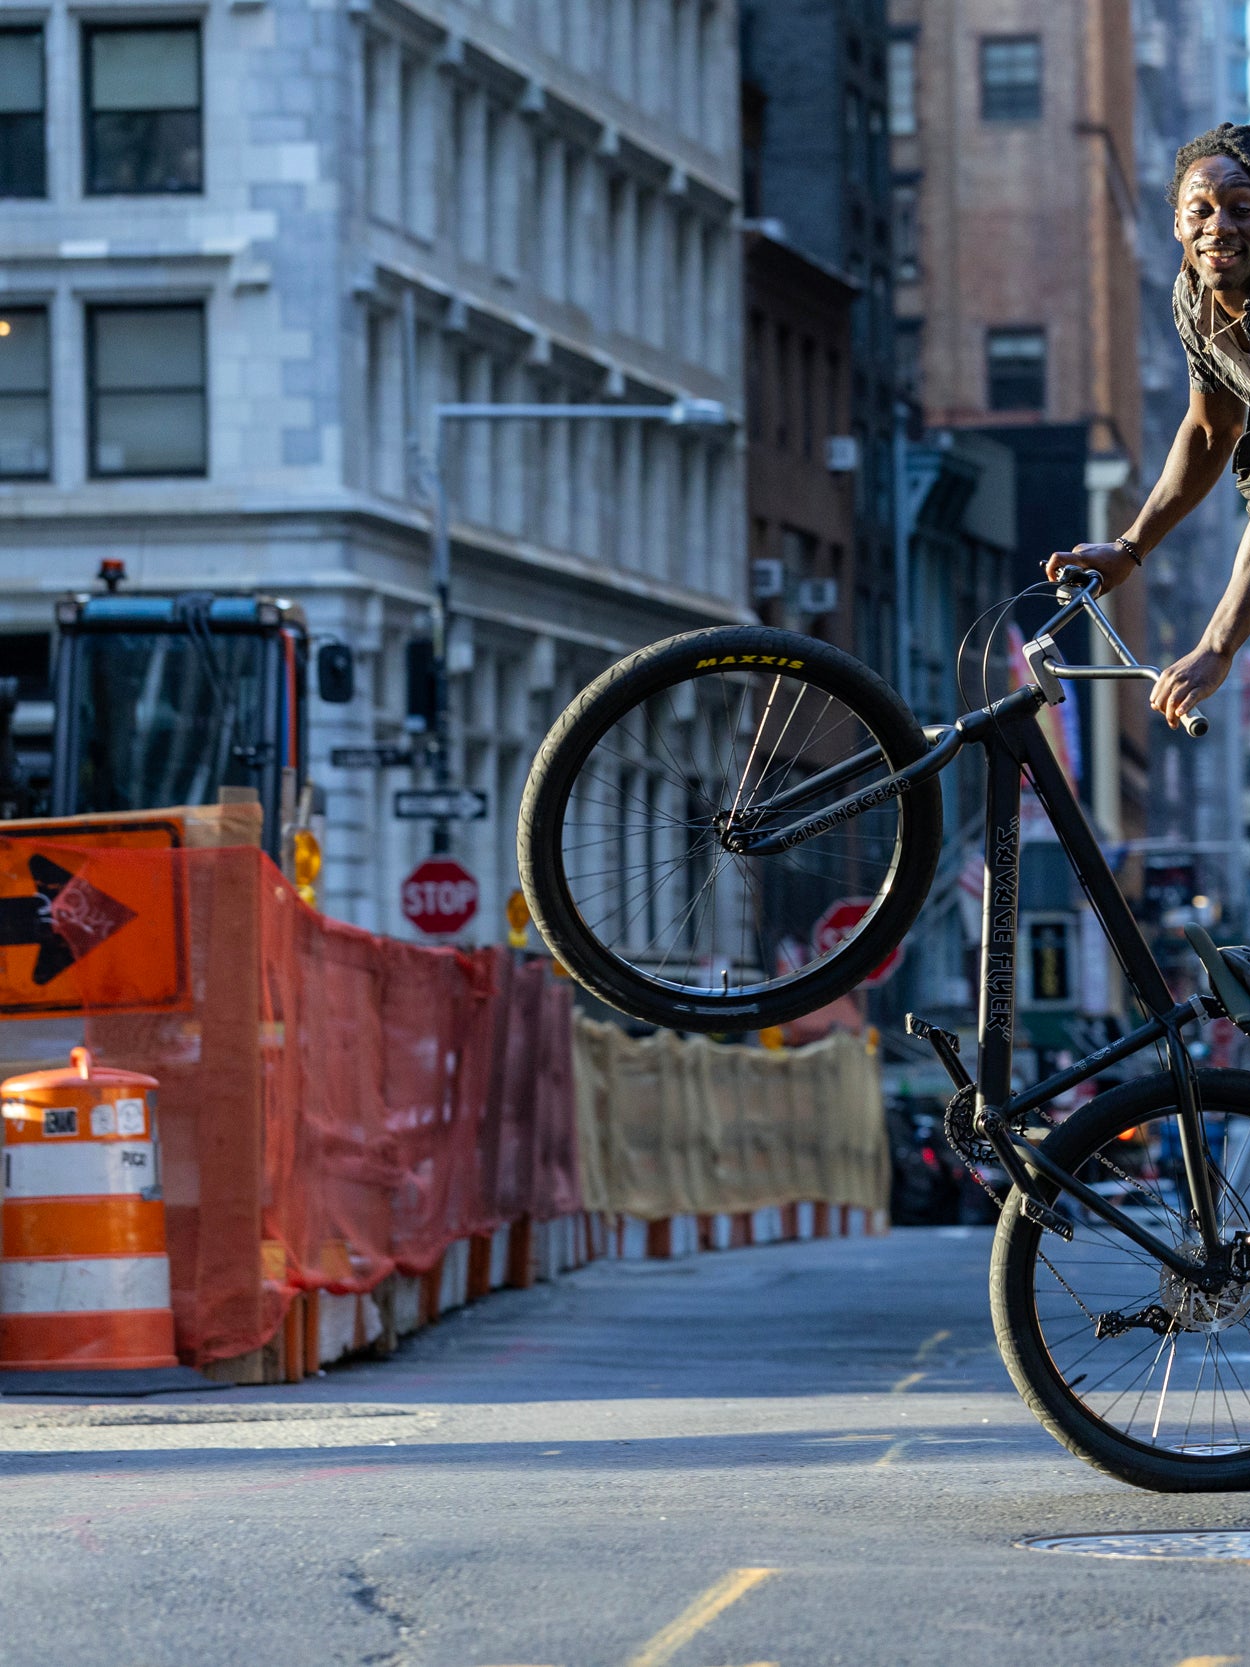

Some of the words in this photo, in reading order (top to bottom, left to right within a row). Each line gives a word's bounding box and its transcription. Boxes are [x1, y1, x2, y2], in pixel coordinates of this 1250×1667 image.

[696, 655, 805, 669] MAXXIS
[780, 801, 862, 849] LANDING
[860, 776, 912, 808] GEAR
[404, 881, 476, 917] STOP
